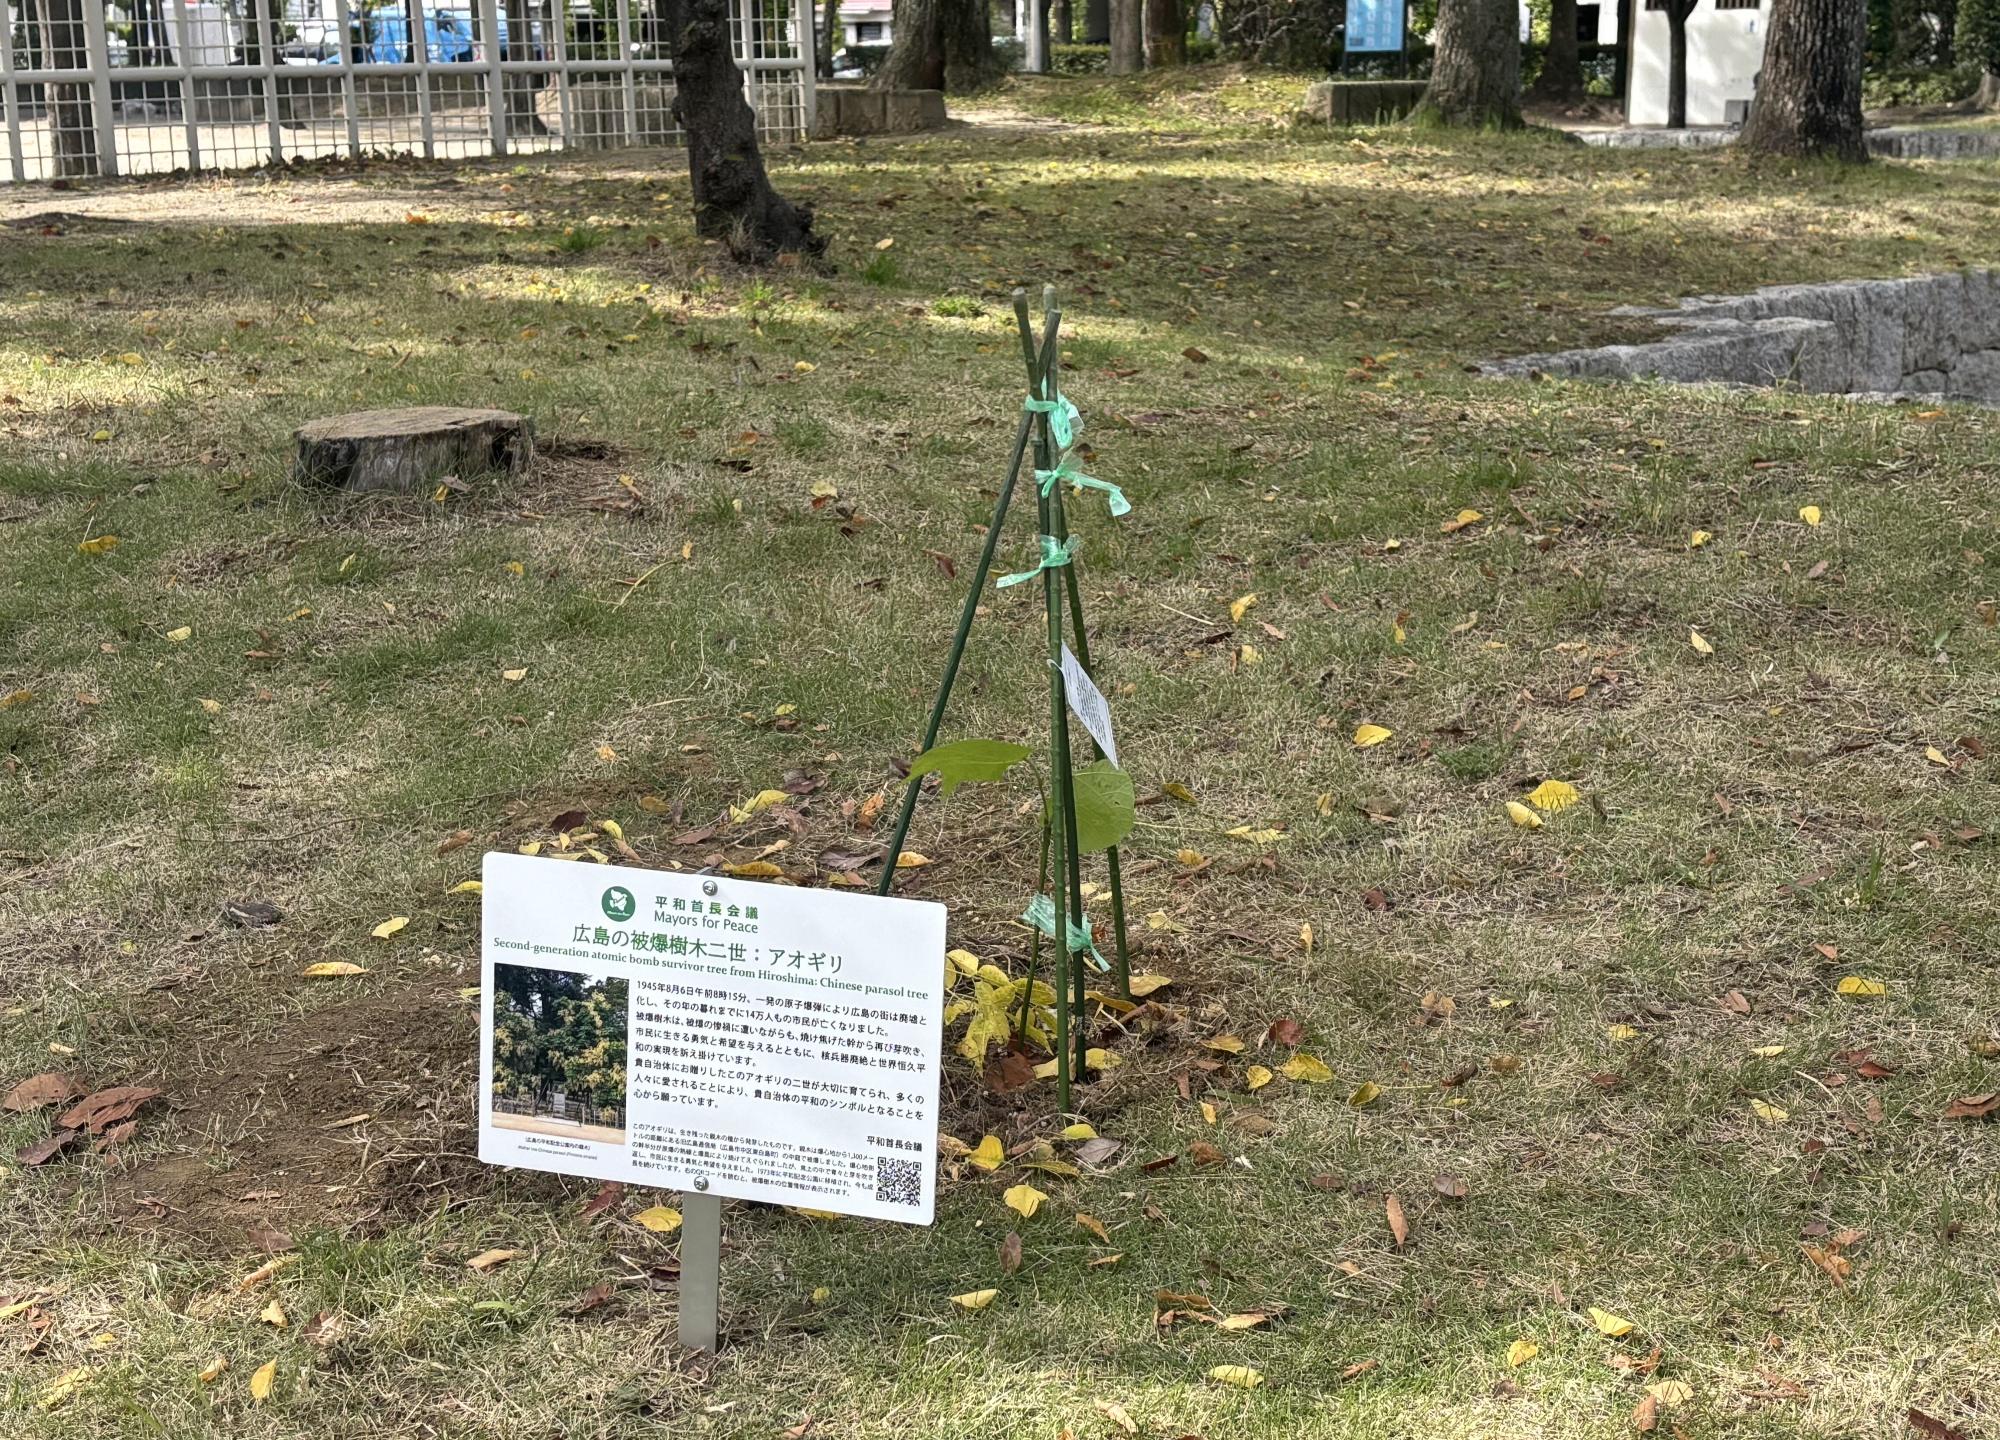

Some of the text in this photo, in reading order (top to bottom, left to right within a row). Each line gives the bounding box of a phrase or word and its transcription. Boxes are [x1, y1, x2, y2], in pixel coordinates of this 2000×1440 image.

[655, 895, 759, 920] 平和首長会議
[654, 909, 759, 934] Mayors for Peace
[572, 923, 842, 974] 広島の被爆樹木二世：アオギリ
[493, 937, 929, 1000] Second-generation atomic bomb survivor tree from Hiroshima: Chinese parasol tree
[635, 1041, 756, 1067] 和の実現を訴え掛けています。
[634, 1057, 925, 1105] 貴自治体にお贈りしたこのアオギリの二世が大切に育てられ、多くの
[633, 1088, 719, 1109] 心から願っています。
[634, 1073, 924, 1121] 人々に愛されることにより、貴自治体の平和のシンボルとなることを
[866, 1135, 923, 1152] 平和首長会議
